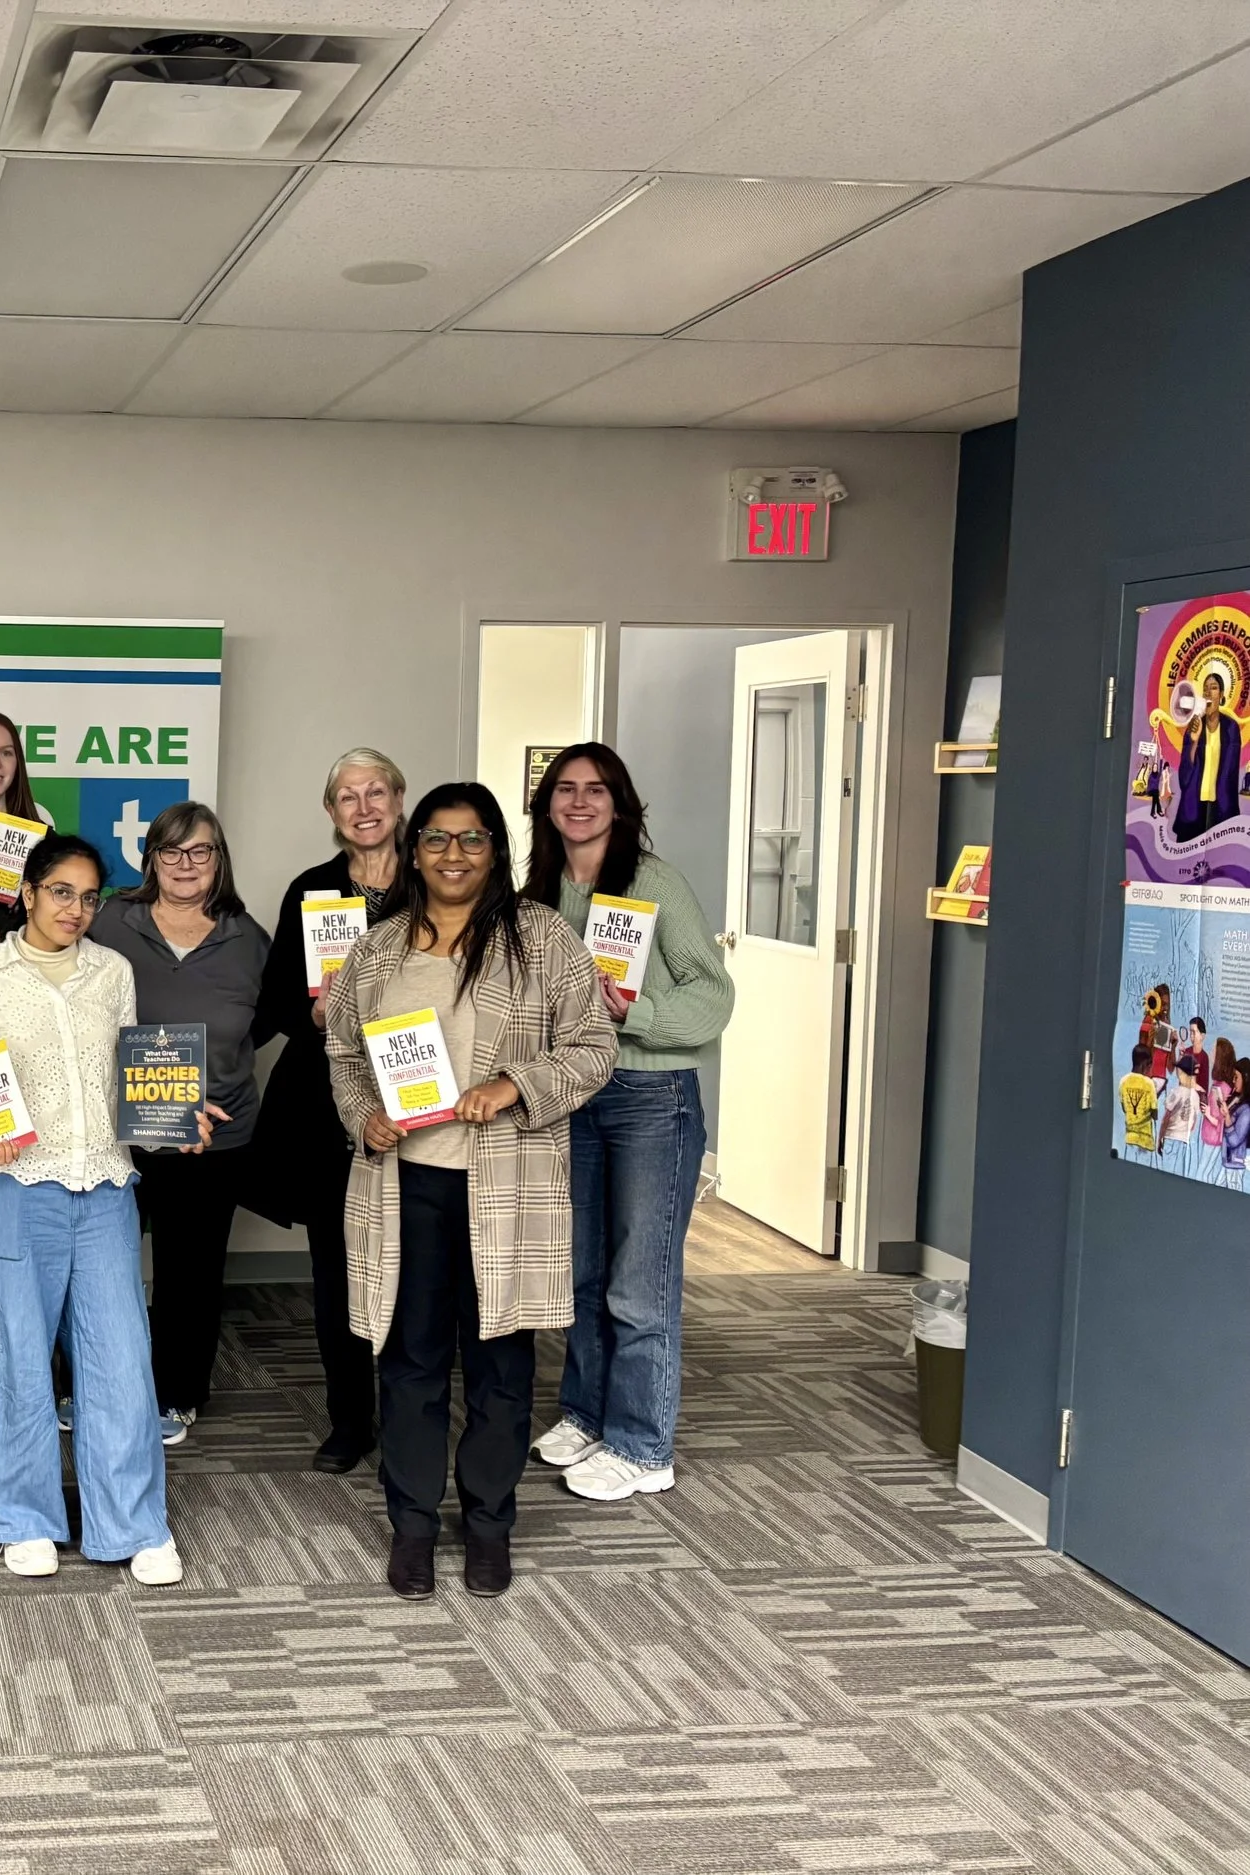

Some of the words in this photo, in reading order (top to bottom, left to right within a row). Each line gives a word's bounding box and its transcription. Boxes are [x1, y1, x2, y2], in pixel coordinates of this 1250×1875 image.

[747, 502, 817, 555] EXIT
[1167, 660, 1180, 688] LES
[1176, 620, 1219, 661] FEMMES
[1221, 620, 1238, 636] EN
[16, 725, 56, 763] E
[75, 726, 189, 765] ARE
[4, 829, 28, 845] NEW
[1179, 893, 1213, 904] SPOTLIGHT
[1214, 896, 1228, 905] ON
[1228, 897, 1250, 907] MATH
[322, 913, 347, 928] NEW
[607, 911, 634, 929] NEW
[310, 926, 361, 943] TEACHER
[593, 923, 643, 945] TEACHER
[1223, 929, 1248, 940] MATH
[316, 945, 354, 959] CONFIDENTI
[592, 941, 635, 957] CONFIDENTIAL
[1222, 940, 1250, 952] EVERY
[388, 1031, 418, 1052] NEW
[378, 1043, 438, 1070] TEACHER
[123, 1066, 200, 1082] TEACHER
[388, 1064, 437, 1082] CONFIDENTIAL
[125, 1082, 200, 1103] MOVES
[132, 1128, 166, 1137] SHANNON
[166, 1130, 187, 1138] HAZEL
